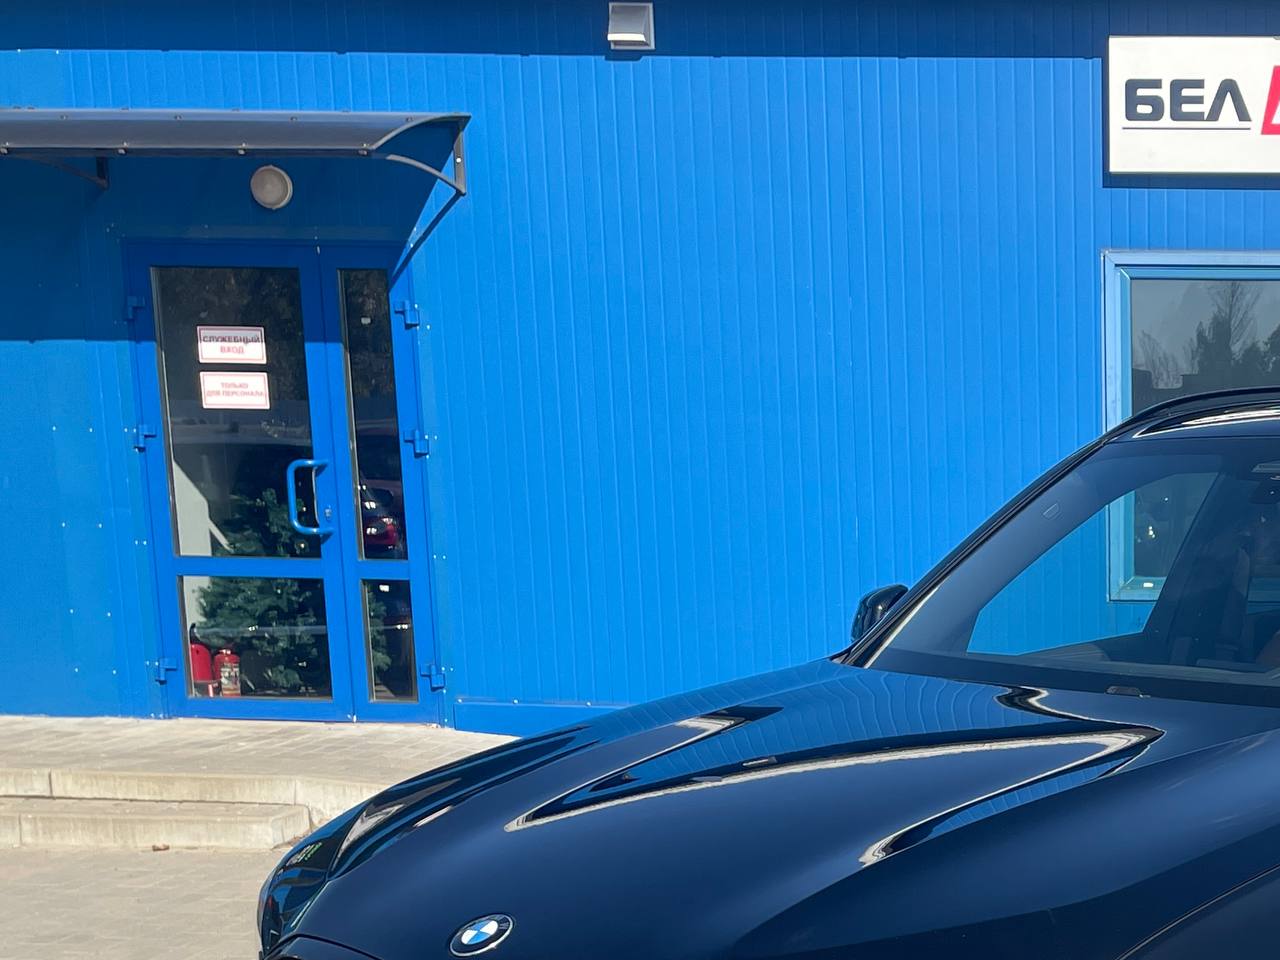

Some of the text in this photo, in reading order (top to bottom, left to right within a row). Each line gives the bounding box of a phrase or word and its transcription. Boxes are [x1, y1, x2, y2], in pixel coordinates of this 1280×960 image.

[1123, 78, 1252, 122] БЕЛ
[202, 334, 261, 344] СЛУЖЕБНЫЙ
[220, 346, 245, 354] ВХОД
